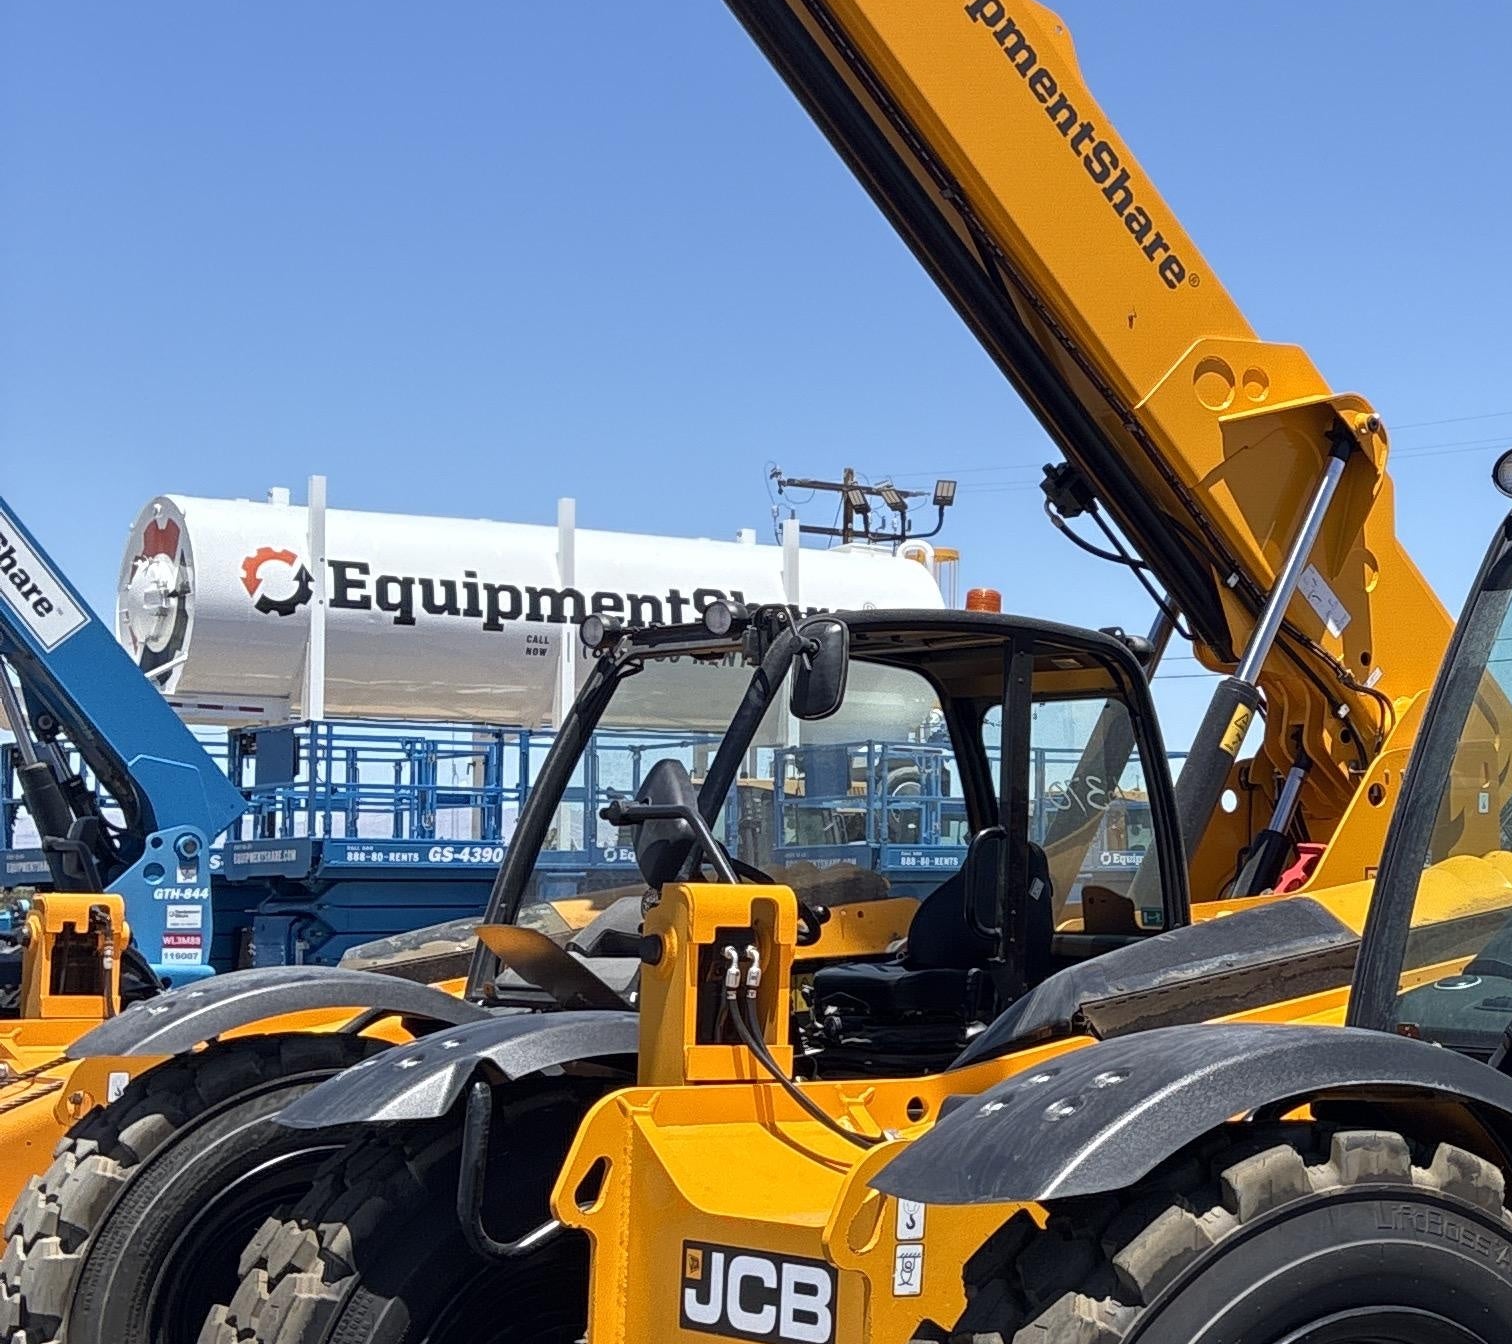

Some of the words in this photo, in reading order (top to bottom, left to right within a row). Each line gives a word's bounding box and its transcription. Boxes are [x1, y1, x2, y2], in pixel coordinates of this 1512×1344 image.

[526, 634, 550, 645] CALL
[525, 647, 548, 657] NOW
[428, 847, 504, 864] GS-4390
[153, 887, 210, 901] GTH-844
[684, 1251, 832, 1344] JCB
